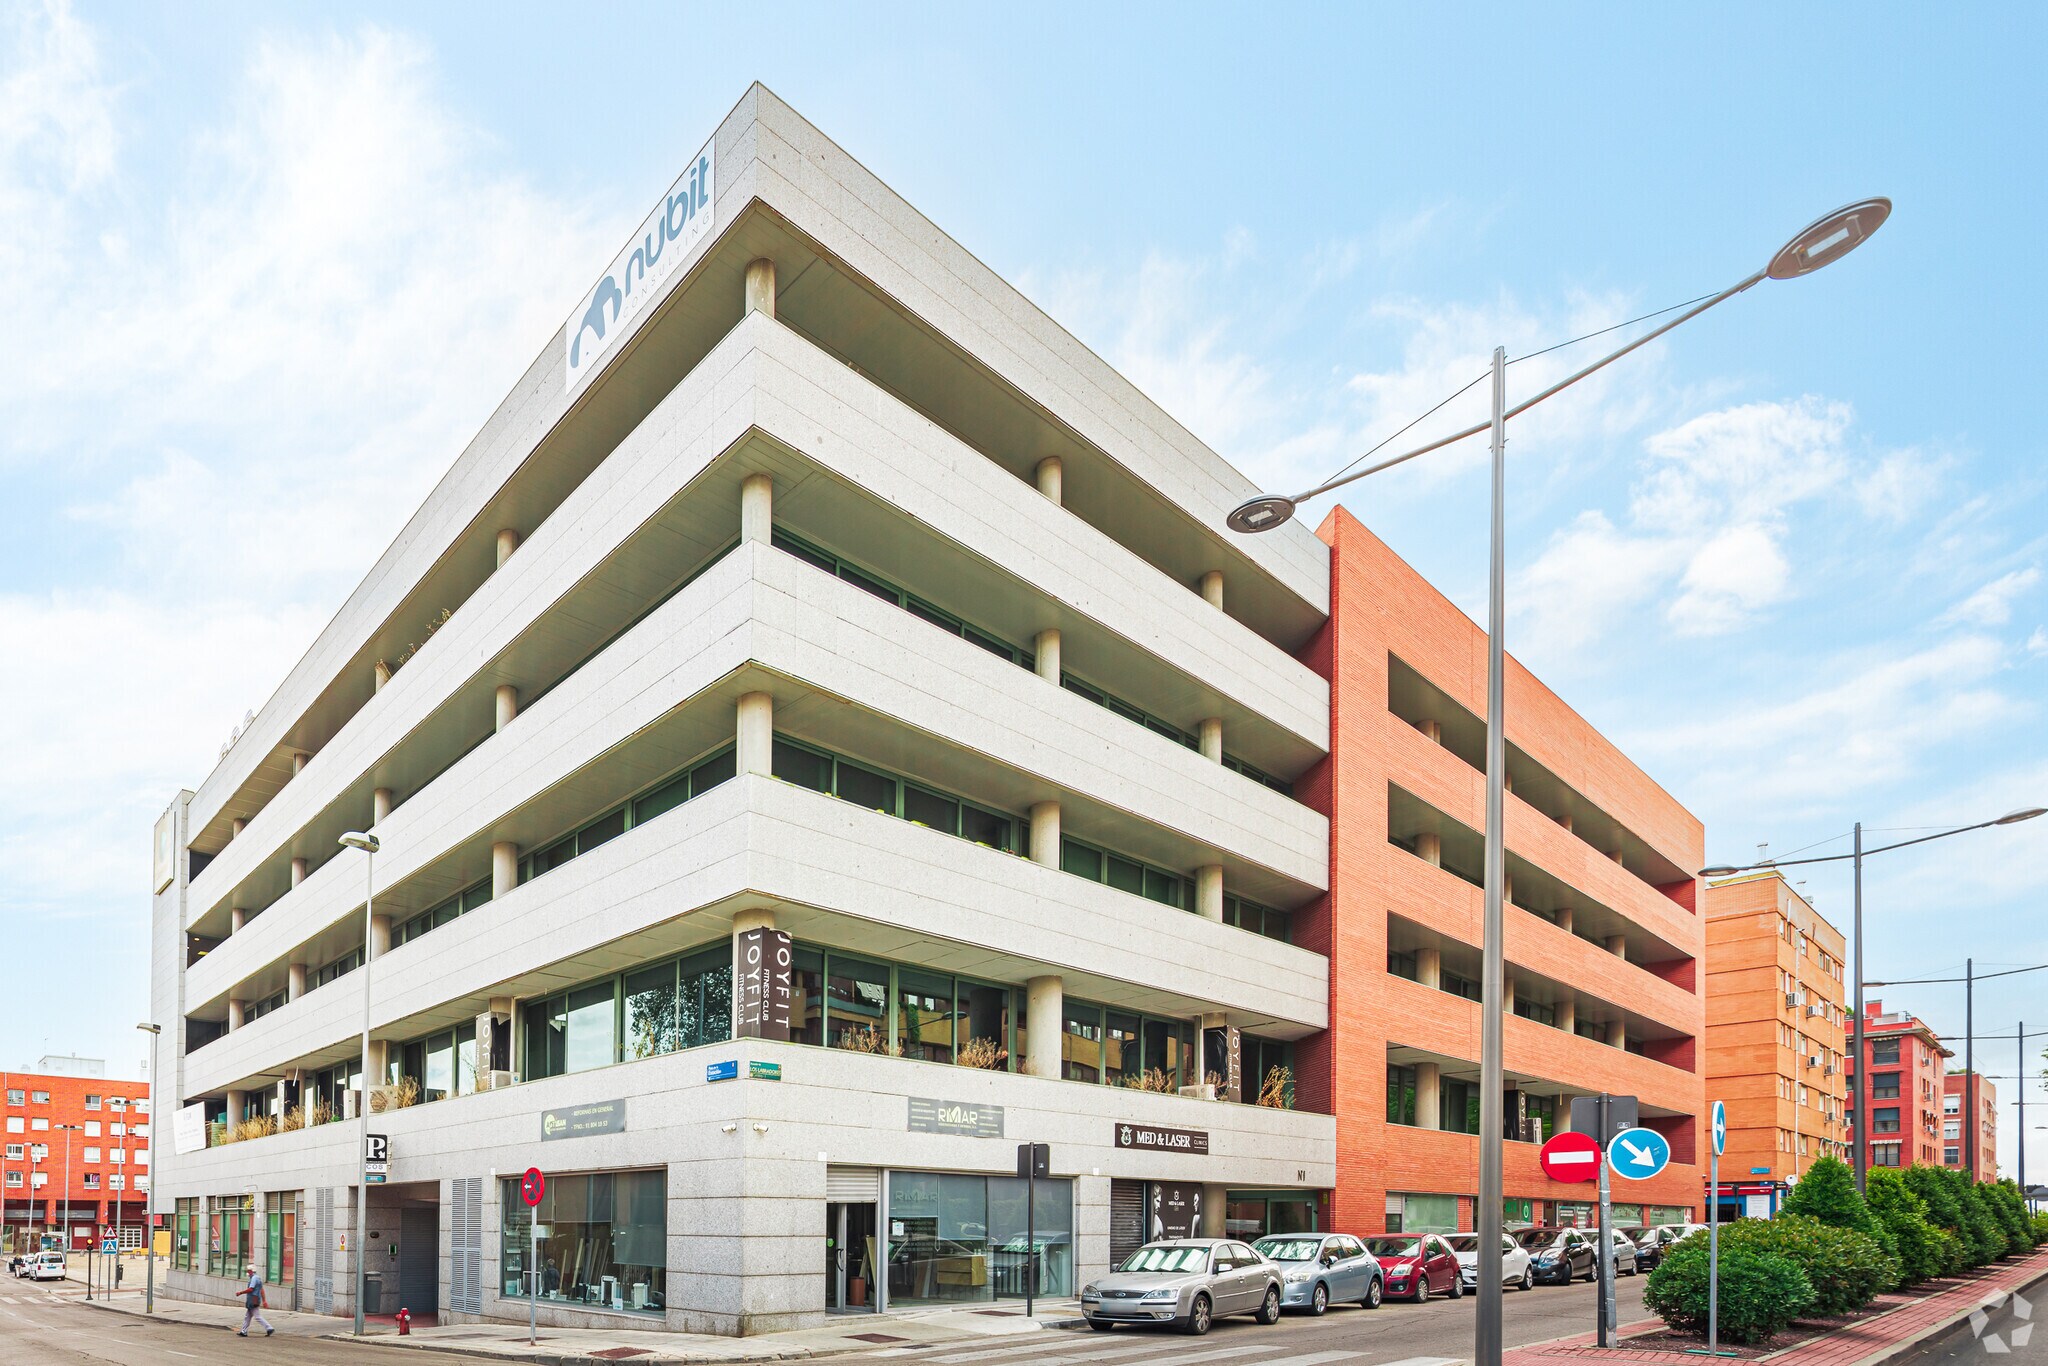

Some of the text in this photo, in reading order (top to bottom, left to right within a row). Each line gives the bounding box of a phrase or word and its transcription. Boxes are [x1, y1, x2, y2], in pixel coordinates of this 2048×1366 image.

[625, 156, 709, 298] nubit
[622, 211, 710, 318] CONSULTING
[746, 934, 760, 1024] JOYFIT
[775, 933, 790, 1028] JOYFIT
[1232, 1027, 1240, 1092] JOYFIT
[366, 1137, 385, 1158] P
[938, 1105, 977, 1125] RIMAR
[1136, 1131, 1156, 1145] MED
[1157, 1133, 1164, 1146] &
[1165, 1133, 1191, 1148] LASER
[895, 1188, 938, 1201] RIMAR
